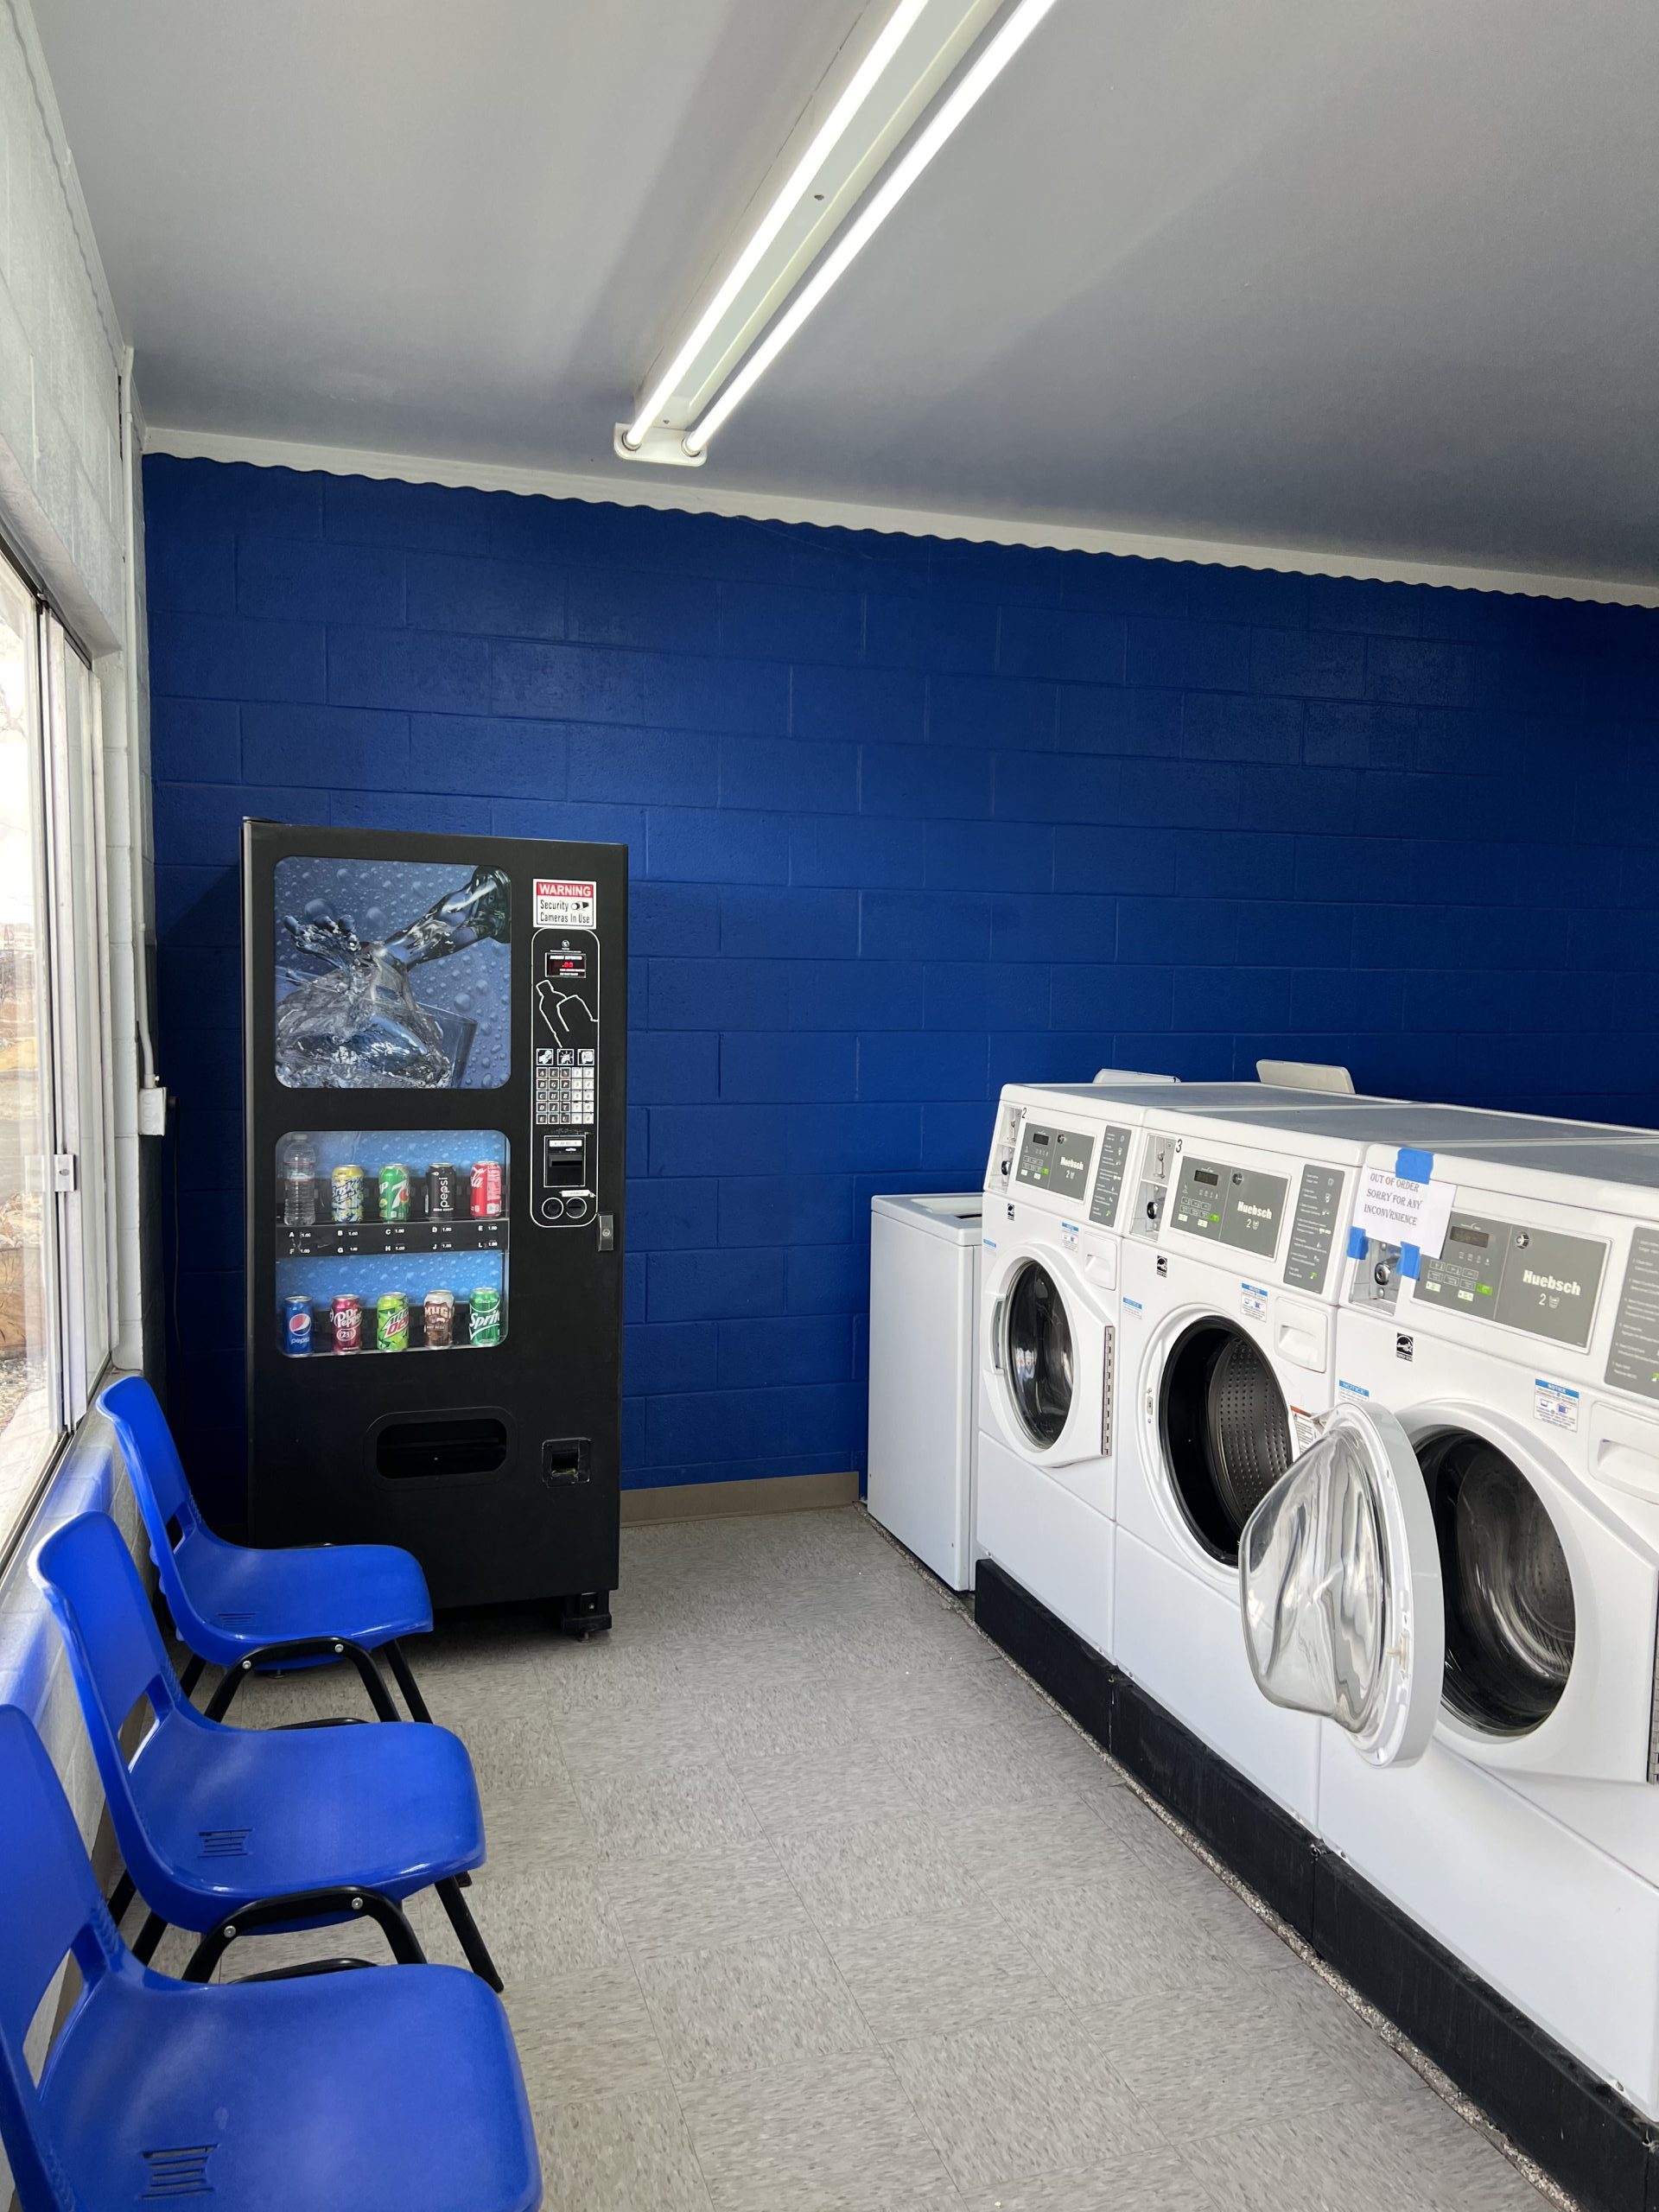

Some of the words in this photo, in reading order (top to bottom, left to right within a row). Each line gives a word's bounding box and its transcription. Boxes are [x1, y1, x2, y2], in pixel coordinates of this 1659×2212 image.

[539, 884, 592, 897] WARNING
[540, 899, 569, 912] Security
[540, 912, 569, 923] Cameras
[570, 913, 576, 923] In
[578, 913, 590, 924] Use
[1021, 1107, 1027, 1119] 2
[1176, 1139, 1183, 1153] 3
[1065, 1169, 1071, 1179] 2
[1370, 1173, 1384, 1184] OUT
[1385, 1176, 1395, 1186] OF
[1396, 1179, 1420, 1192] ORDER
[438, 1177, 450, 1208] pepsi
[1366, 1188, 1393, 1202] SORRY
[1392, 1194, 1407, 1207] FOR
[1407, 1198, 1423, 1211] ANY
[1237, 1200, 1274, 1219] Huebsch
[1246, 1218, 1252, 1229] 2
[1522, 1268, 1582, 1296] Huebsch
[1538, 1293, 1548, 1306] 2
[346, 1308, 359, 1317] Dr
[424, 1306, 448, 1319] MUG
